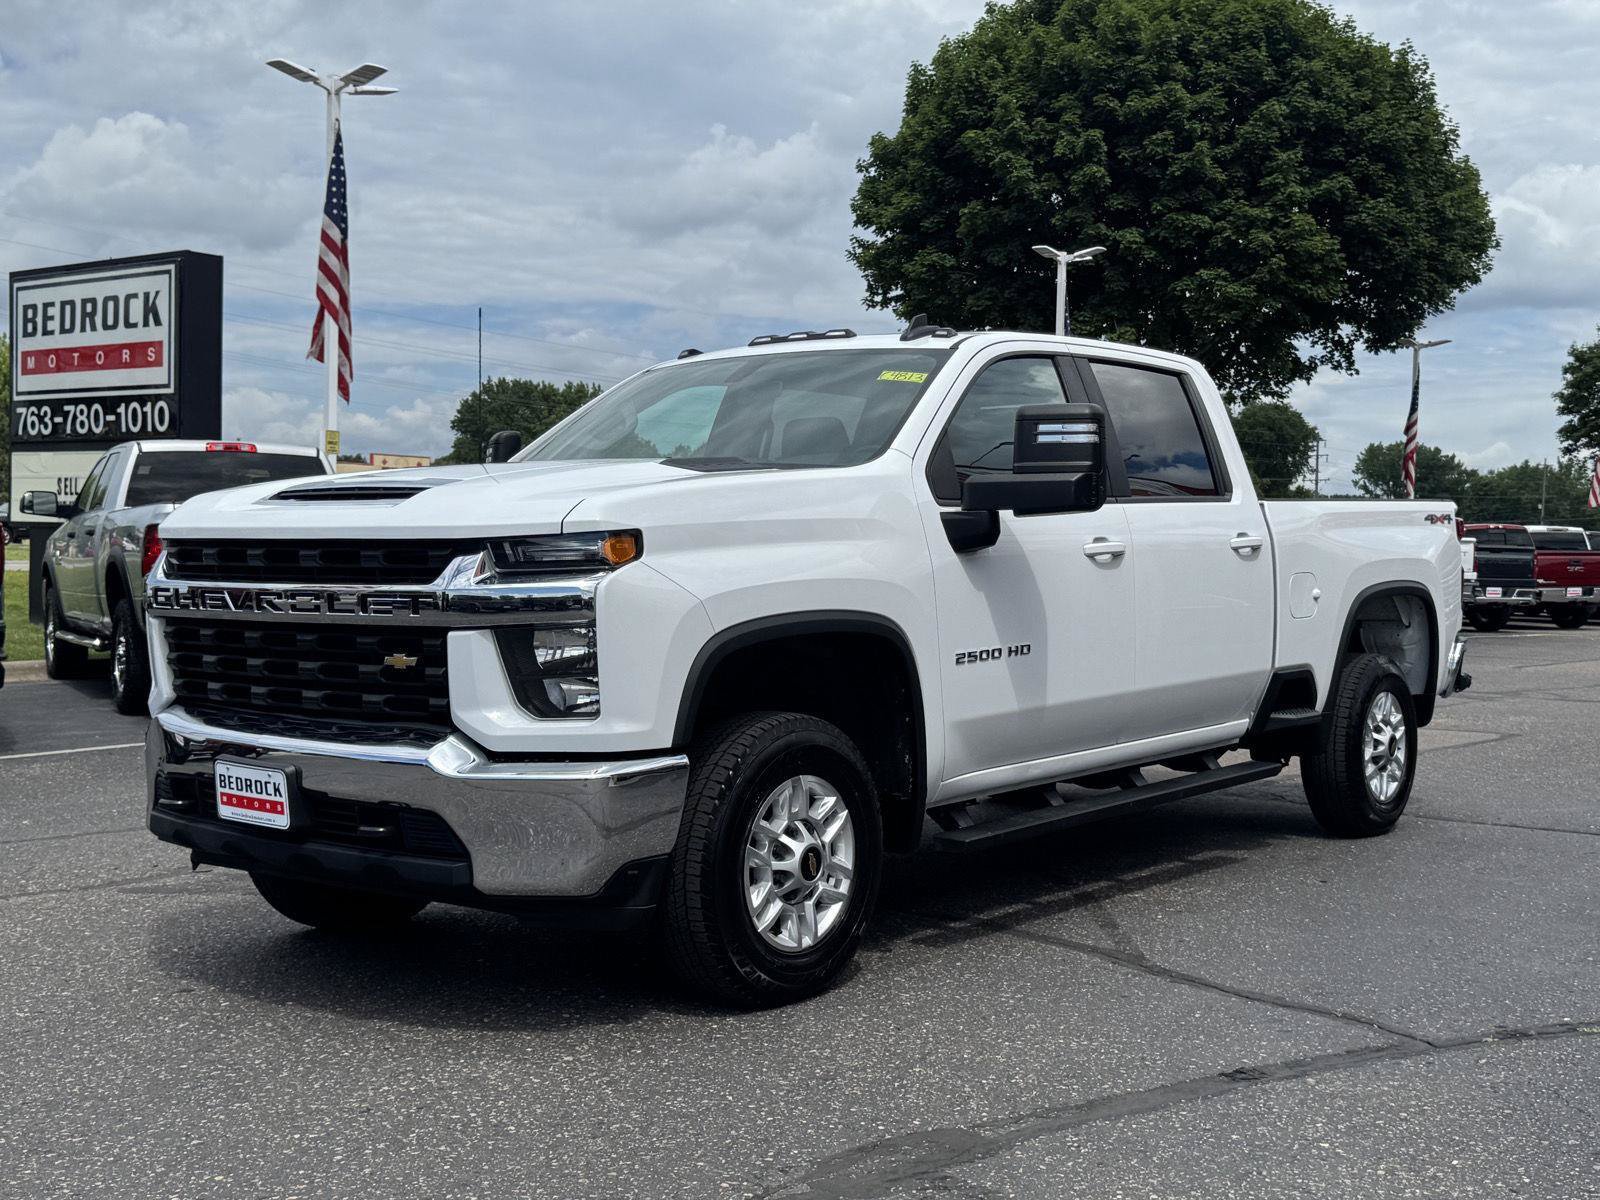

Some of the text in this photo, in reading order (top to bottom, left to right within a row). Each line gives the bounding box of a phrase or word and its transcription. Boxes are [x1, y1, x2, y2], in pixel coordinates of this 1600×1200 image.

[22, 290, 163, 338] BEDROCK
[27, 347, 156, 370] MOTORS
[16, 400, 170, 436] 763-780-1010
[57, 477, 80, 496] SELL
[152, 586, 435, 617] CHEVROLET
[955, 643, 1031, 666] 2500 HD
[219, 773, 284, 798] BEDROCK
[222, 795, 282, 812] MOTORS
